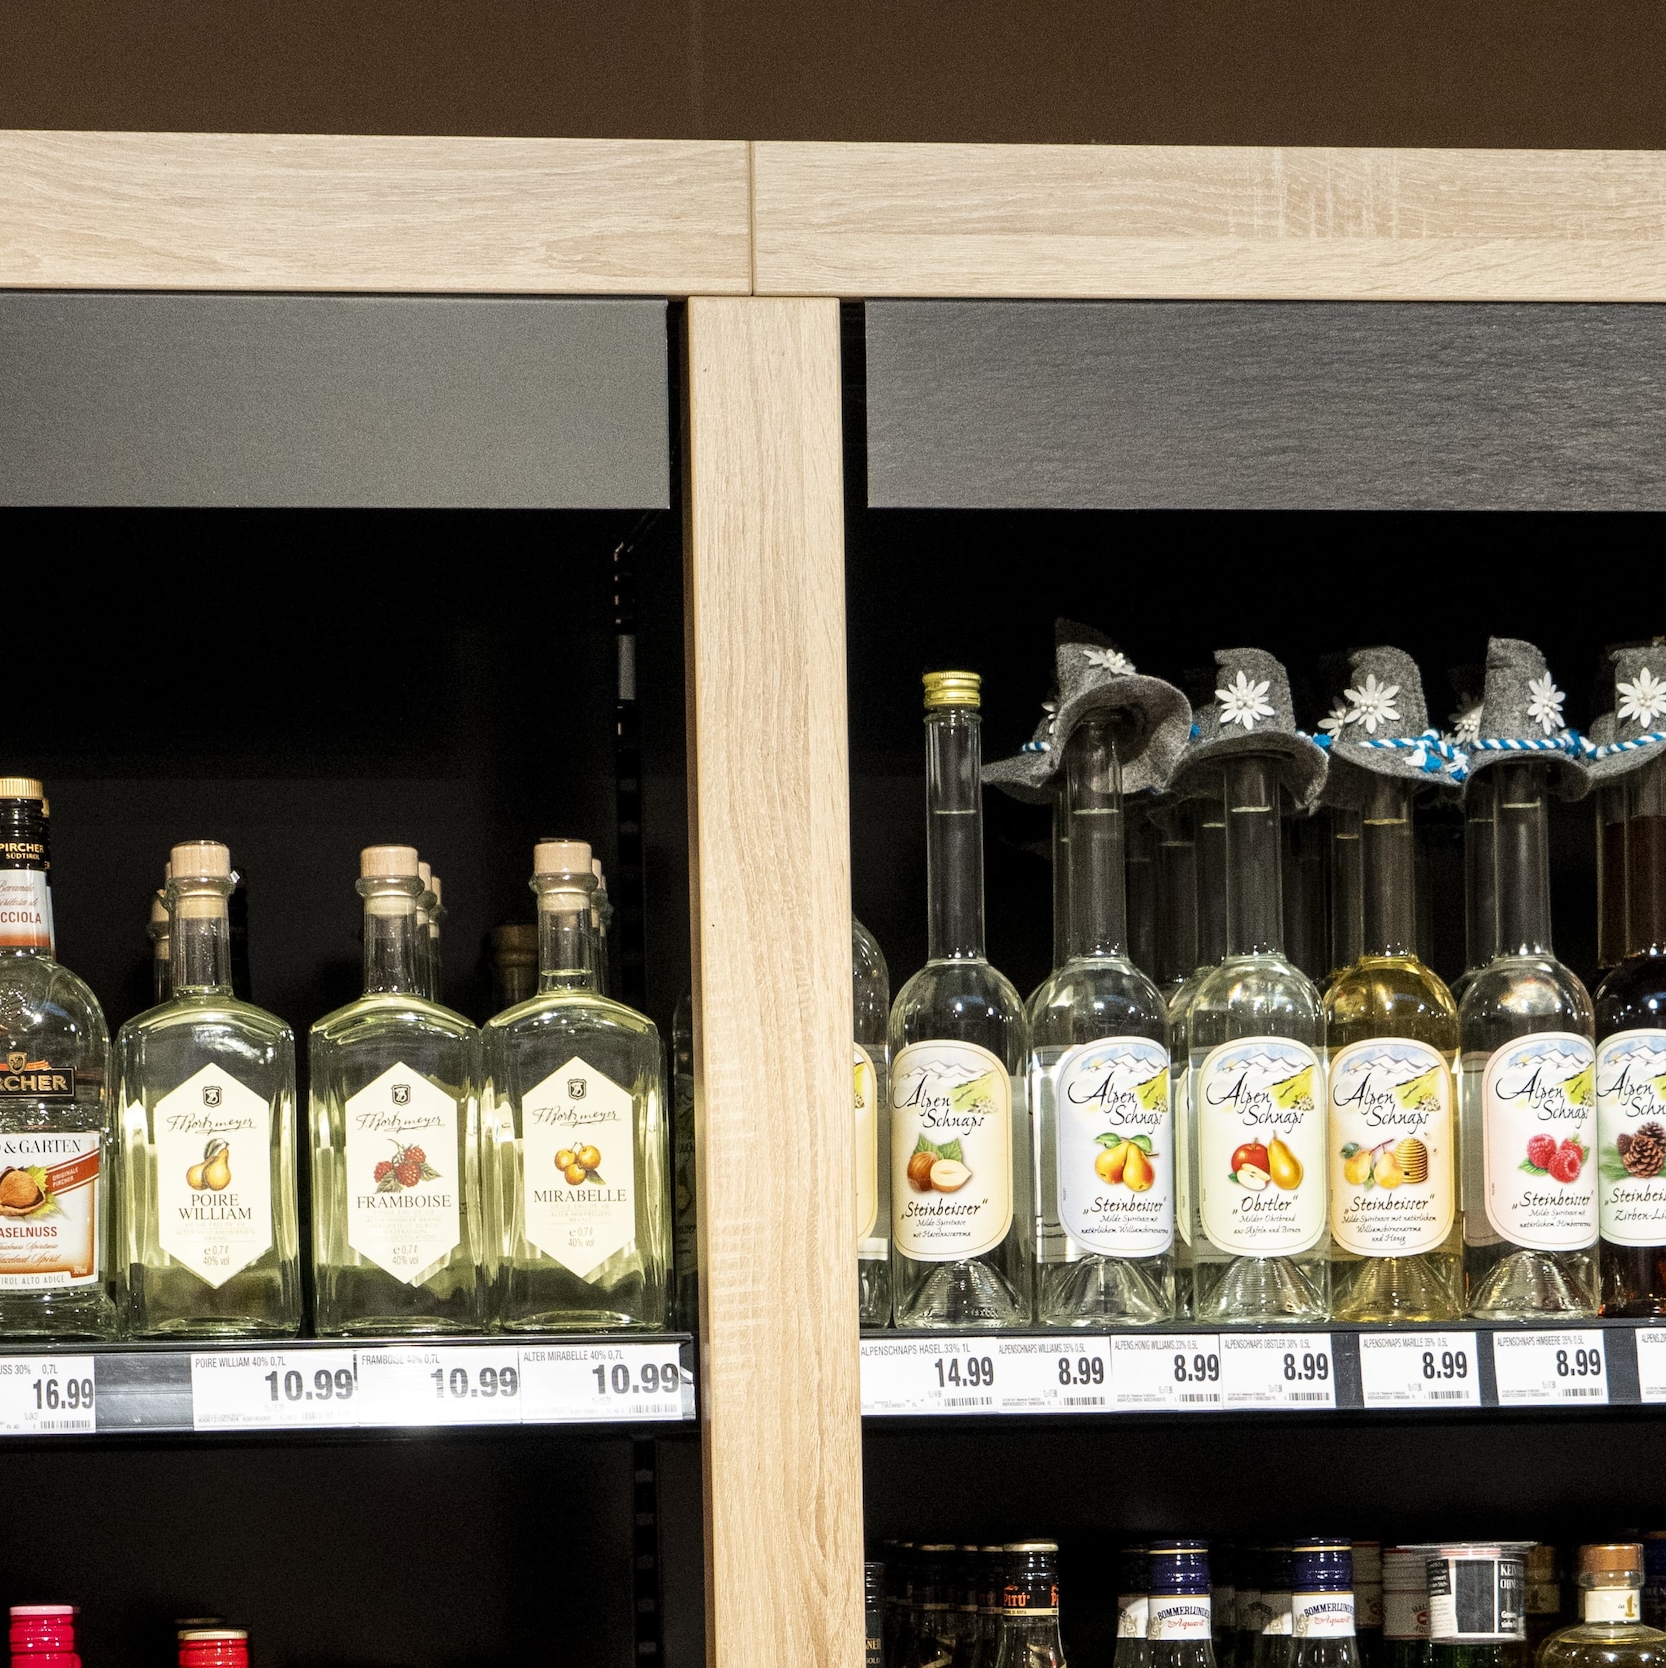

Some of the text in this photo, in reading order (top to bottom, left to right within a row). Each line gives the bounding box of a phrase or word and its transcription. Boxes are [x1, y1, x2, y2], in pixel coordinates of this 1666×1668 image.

[1334, 1073, 1395, 1112] Alpen
[1367, 1106, 1429, 1134] Schnaps
[18, 1139, 81, 1153] GARTEN
[191, 1194, 239, 1206] POIRE
[357, 1194, 451, 1208] FRAMBOISE
[534, 1190, 626, 1202] MIRABELLE
[178, 1207, 252, 1220] WILLIAM
[935, 1357, 994, 1388] 14.99
[1284, 1354, 1328, 1381] 8.99
[1423, 1351, 1467, 1379] 8.99
[592, 1364, 679, 1394] 10.99
[33, 1378, 94, 1409] 16.99
